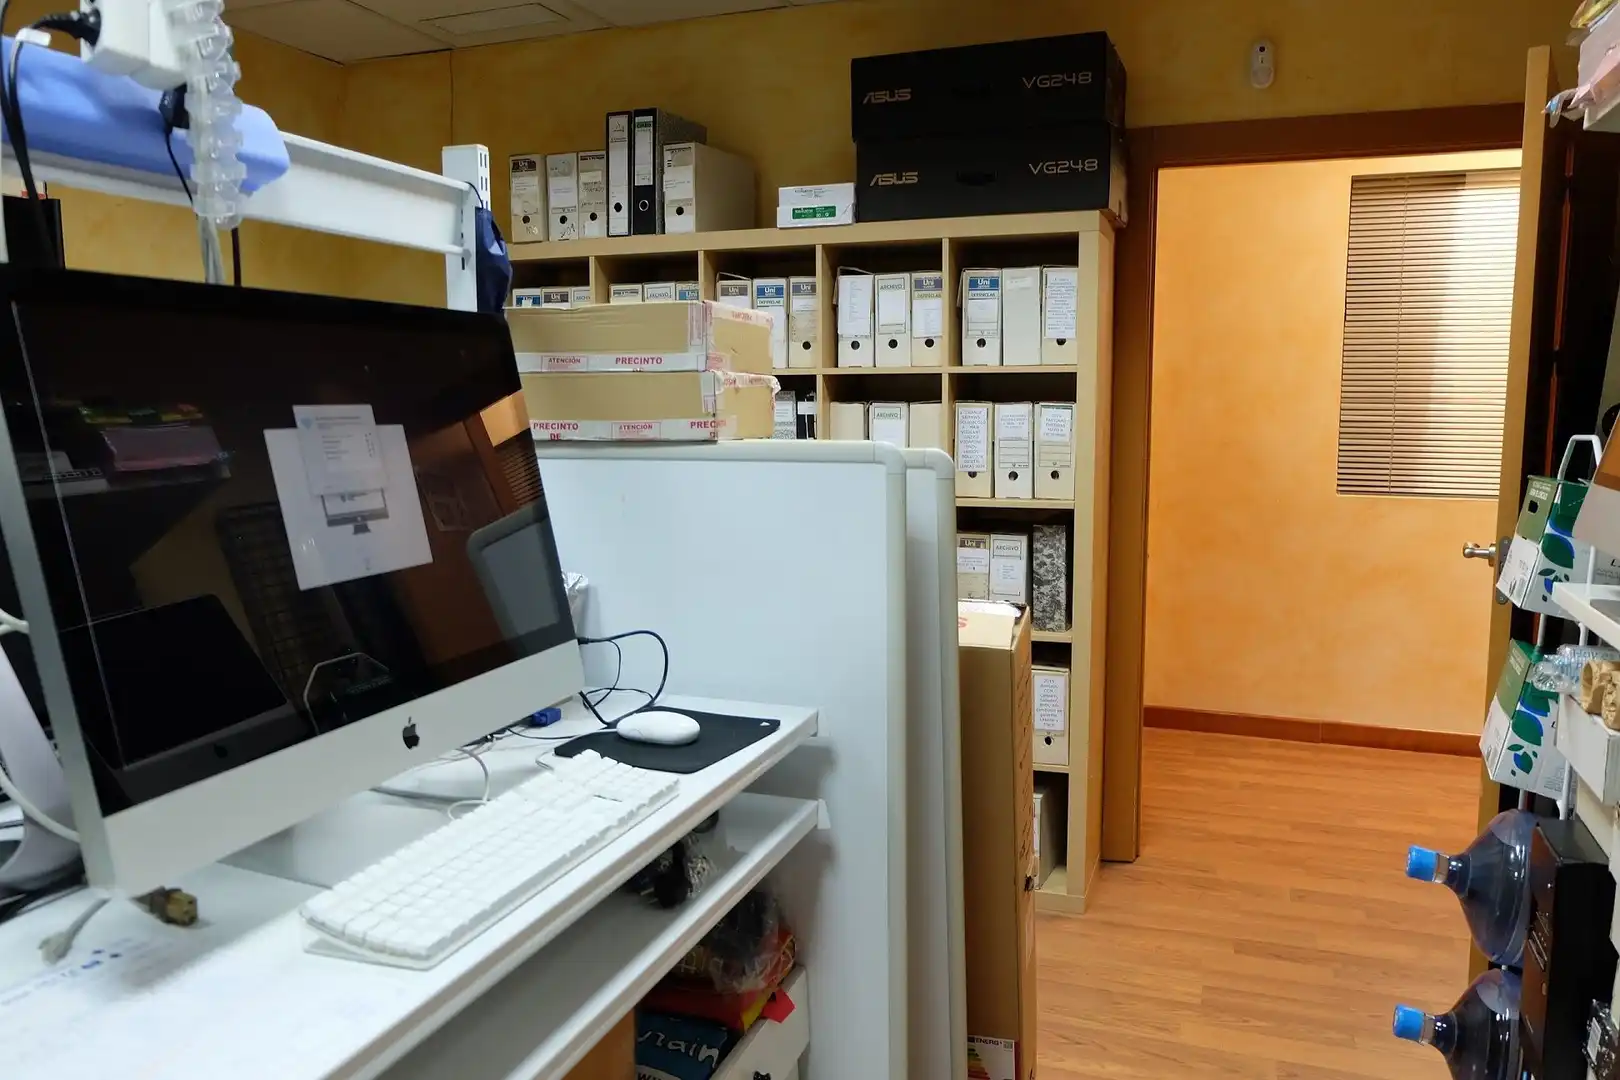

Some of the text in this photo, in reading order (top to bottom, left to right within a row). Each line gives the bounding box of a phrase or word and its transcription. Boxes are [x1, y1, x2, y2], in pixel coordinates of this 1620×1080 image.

[1022, 71, 1092, 89] VG248
[862, 88, 912, 104] ASUS
[1028, 158, 1098, 175] VG248
[870, 171, 919, 187] ASUS
[800, 283, 812, 291] Uni
[879, 283, 904, 291] ARCHIVO
[548, 356, 581, 364] ATENCIÓN
[615, 357, 663, 365] PRECINTO
[533, 422, 579, 431] PRECINTO
[619, 423, 653, 431] ATENCIÓN
[549, 433, 561, 441] DE
